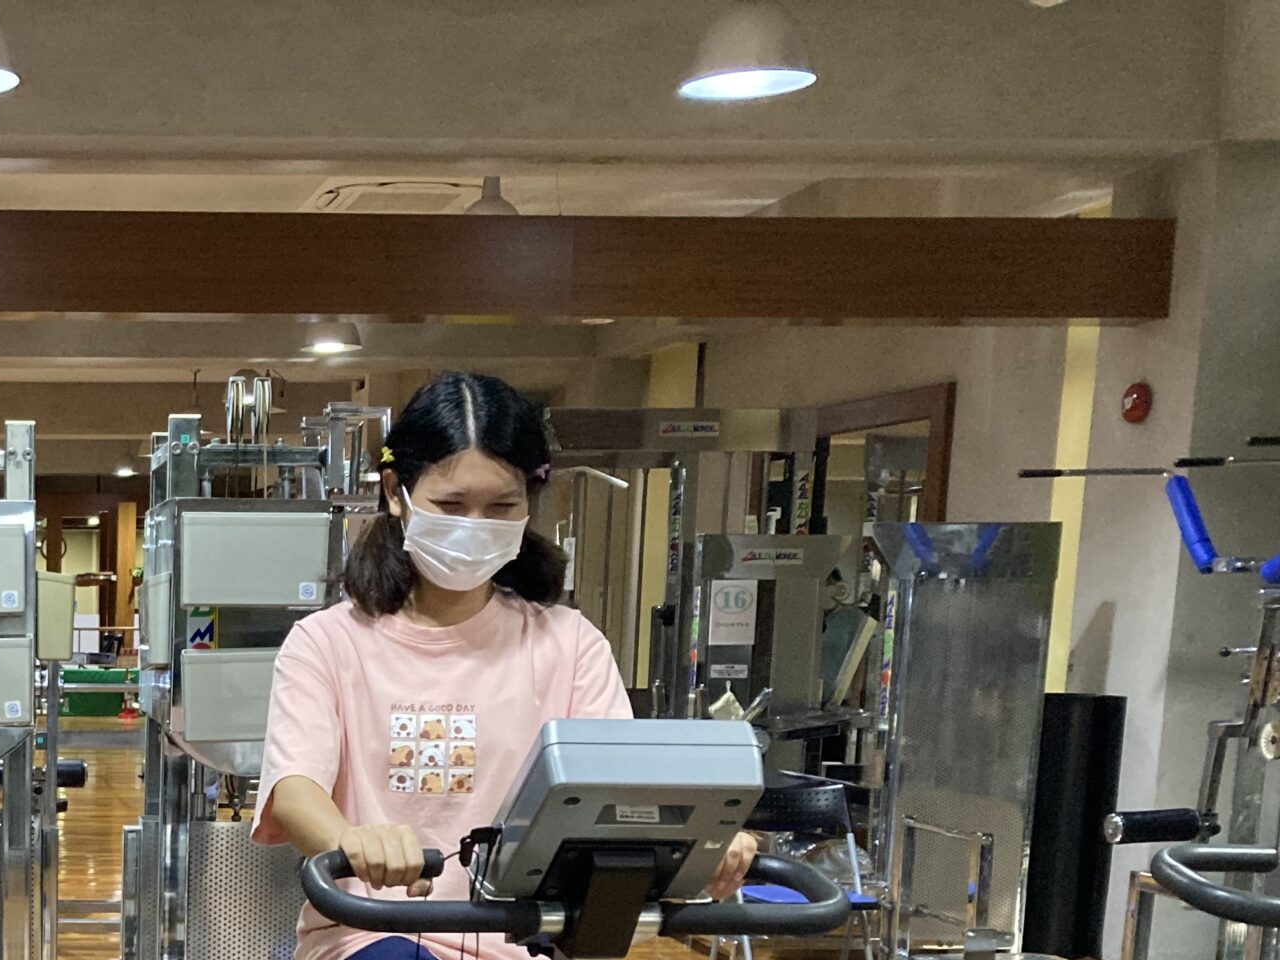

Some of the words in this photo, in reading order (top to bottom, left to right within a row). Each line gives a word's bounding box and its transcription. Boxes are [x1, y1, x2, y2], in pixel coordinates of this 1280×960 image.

[722, 591, 747, 609] 16
[390, 703, 417, 713] HAVE
[418, 704, 426, 712] A
[428, 703, 454, 713] GOOD
[455, 703, 476, 713] DAY
